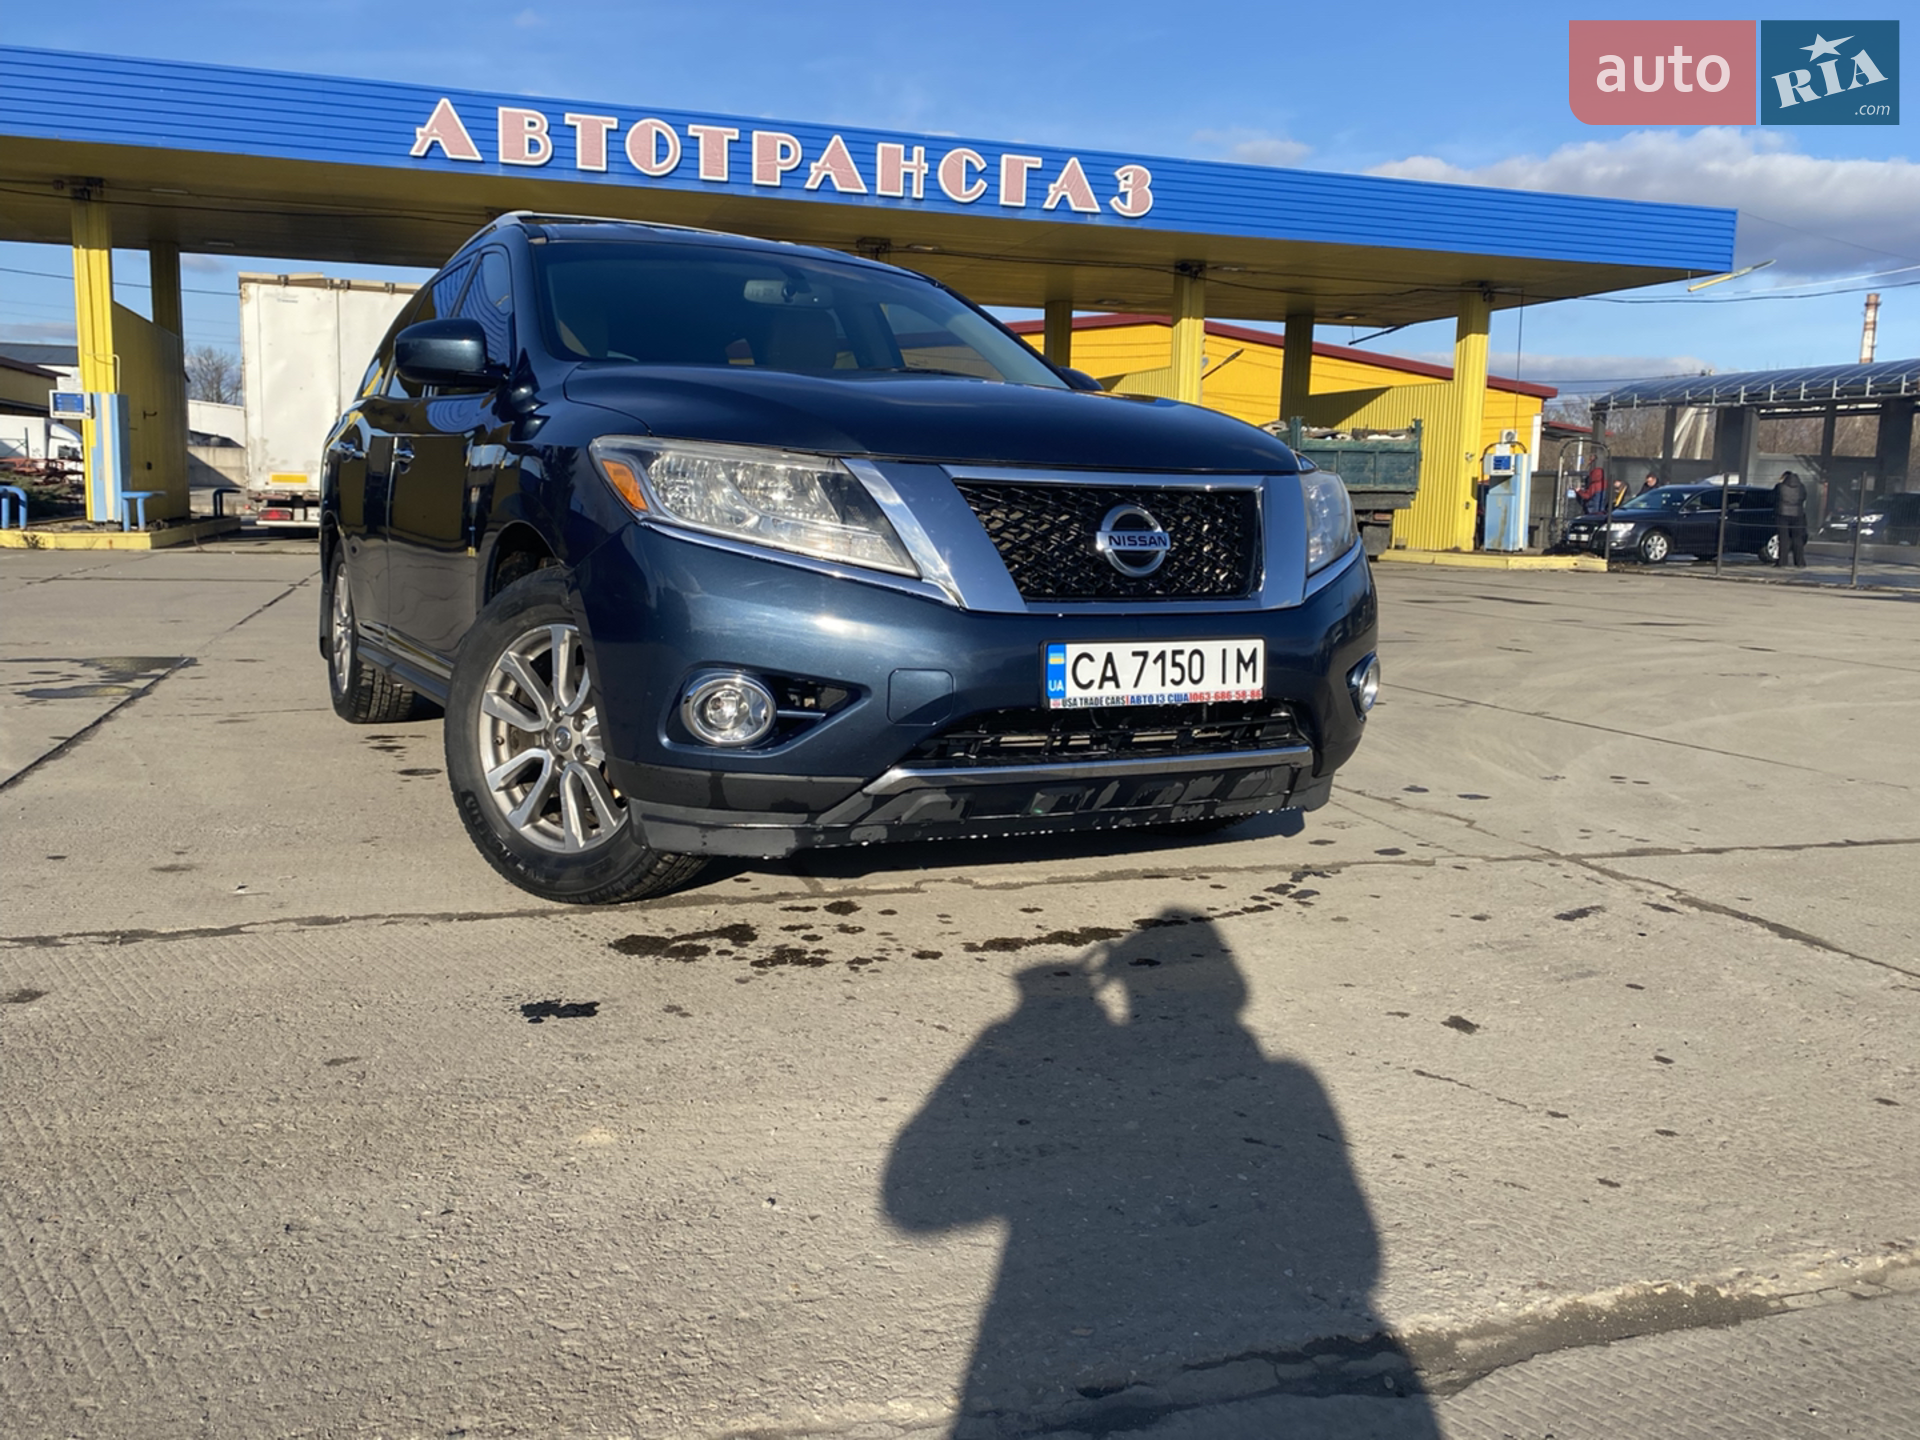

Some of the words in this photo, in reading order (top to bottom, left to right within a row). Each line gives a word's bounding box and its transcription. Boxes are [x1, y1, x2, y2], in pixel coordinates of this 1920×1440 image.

[410, 97, 1155, 218] АВТОТРАНСГАЗ
[1107, 535, 1168, 547] NISSAN
[1071, 651, 1121, 690] CA
[1131, 649, 1205, 688] 7150
[1221, 647, 1257, 685] IM
[1048, 680, 1065, 692] UA
[1061, 698, 1078, 708] USA
[1079, 697, 1103, 707] TRADE
[1104, 696, 1126, 706] CARS
